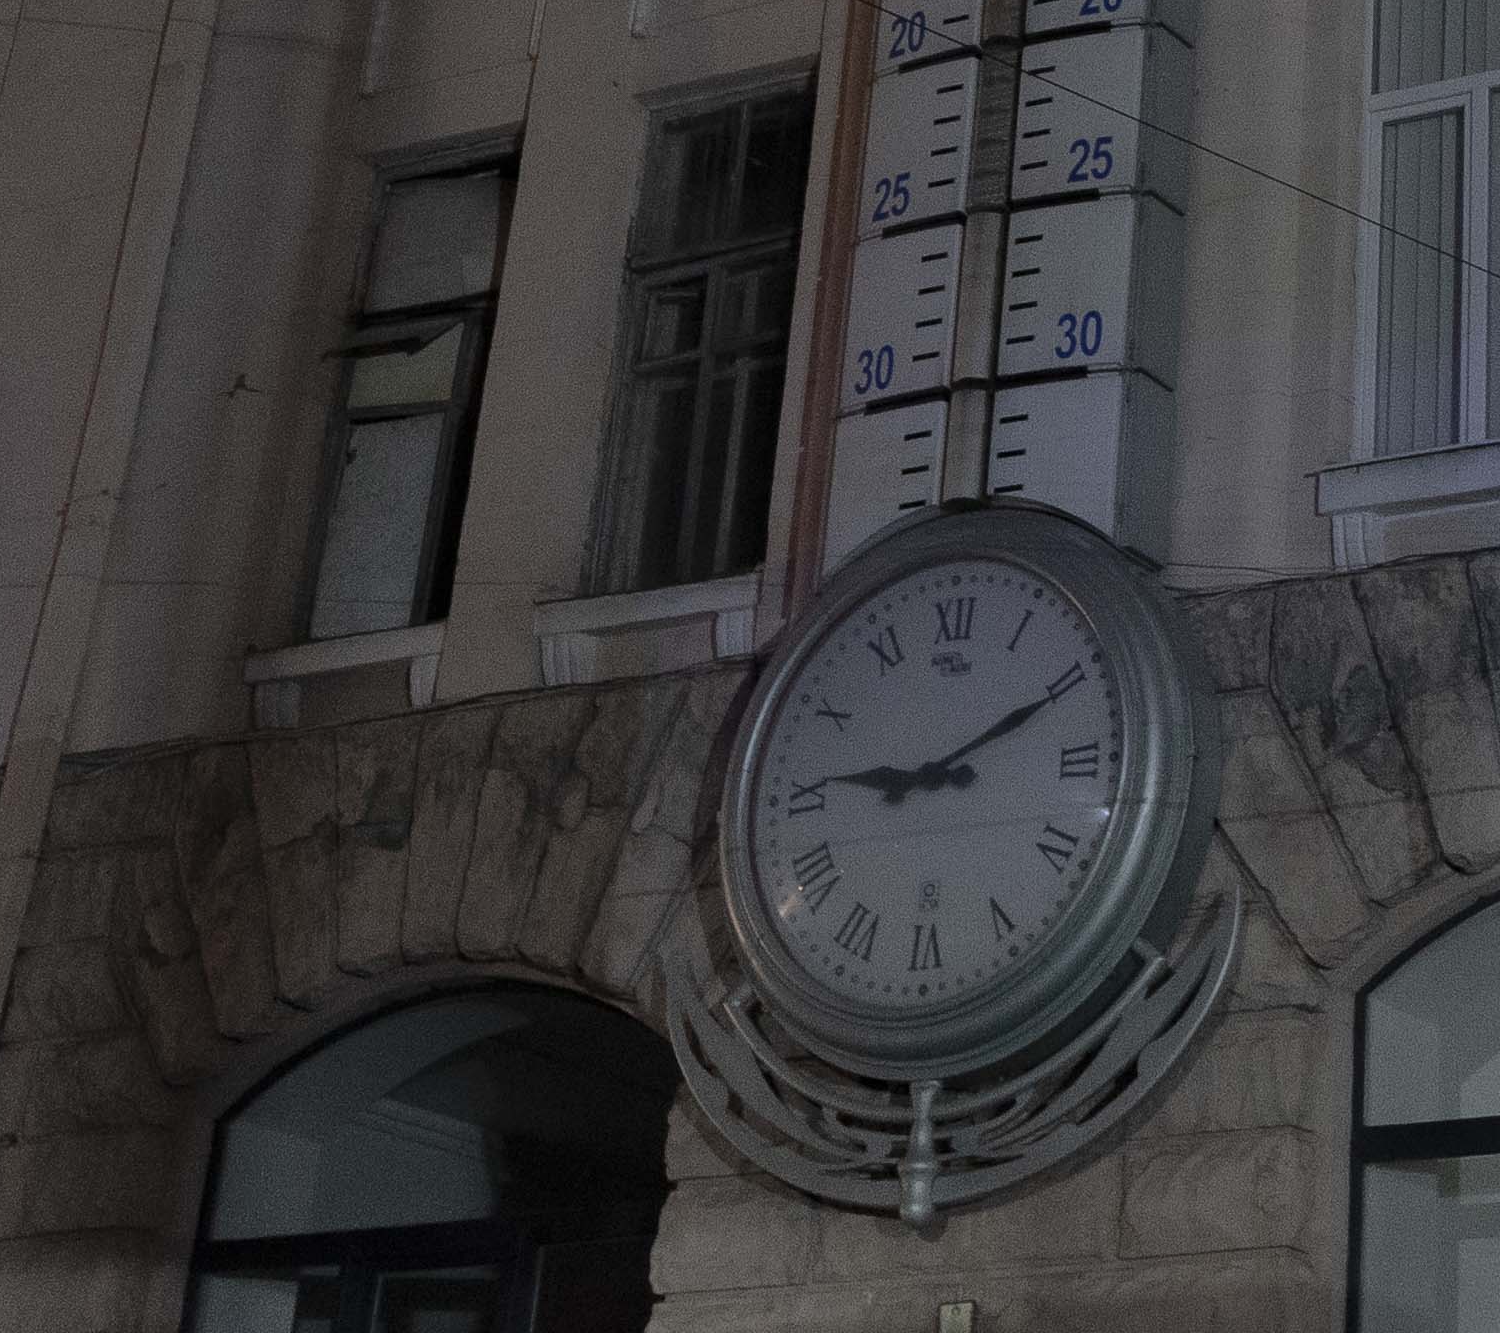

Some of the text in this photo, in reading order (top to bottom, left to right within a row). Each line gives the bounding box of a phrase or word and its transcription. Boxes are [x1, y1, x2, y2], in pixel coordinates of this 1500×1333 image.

[889, 11, 927, 59] 20
[1067, 136, 1113, 183] 25
[872, 172, 911, 222] 25
[1055, 310, 1102, 358] 30
[855, 345, 894, 395] 30
[934, 597, 976, 644] XII
[1007, 610, 1034, 651] I
[867, 625, 904, 676] XI
[1046, 661, 1088, 702] II
[816, 696, 852, 731] X
[1060, 742, 1099, 781] III
[788, 777, 829, 818] IX
[1036, 825, 1079, 874] IV
[793, 842, 841, 915] VIII
[834, 902, 880, 962] VII
[989, 897, 1016, 939] V
[908, 924, 942, 971] VI
